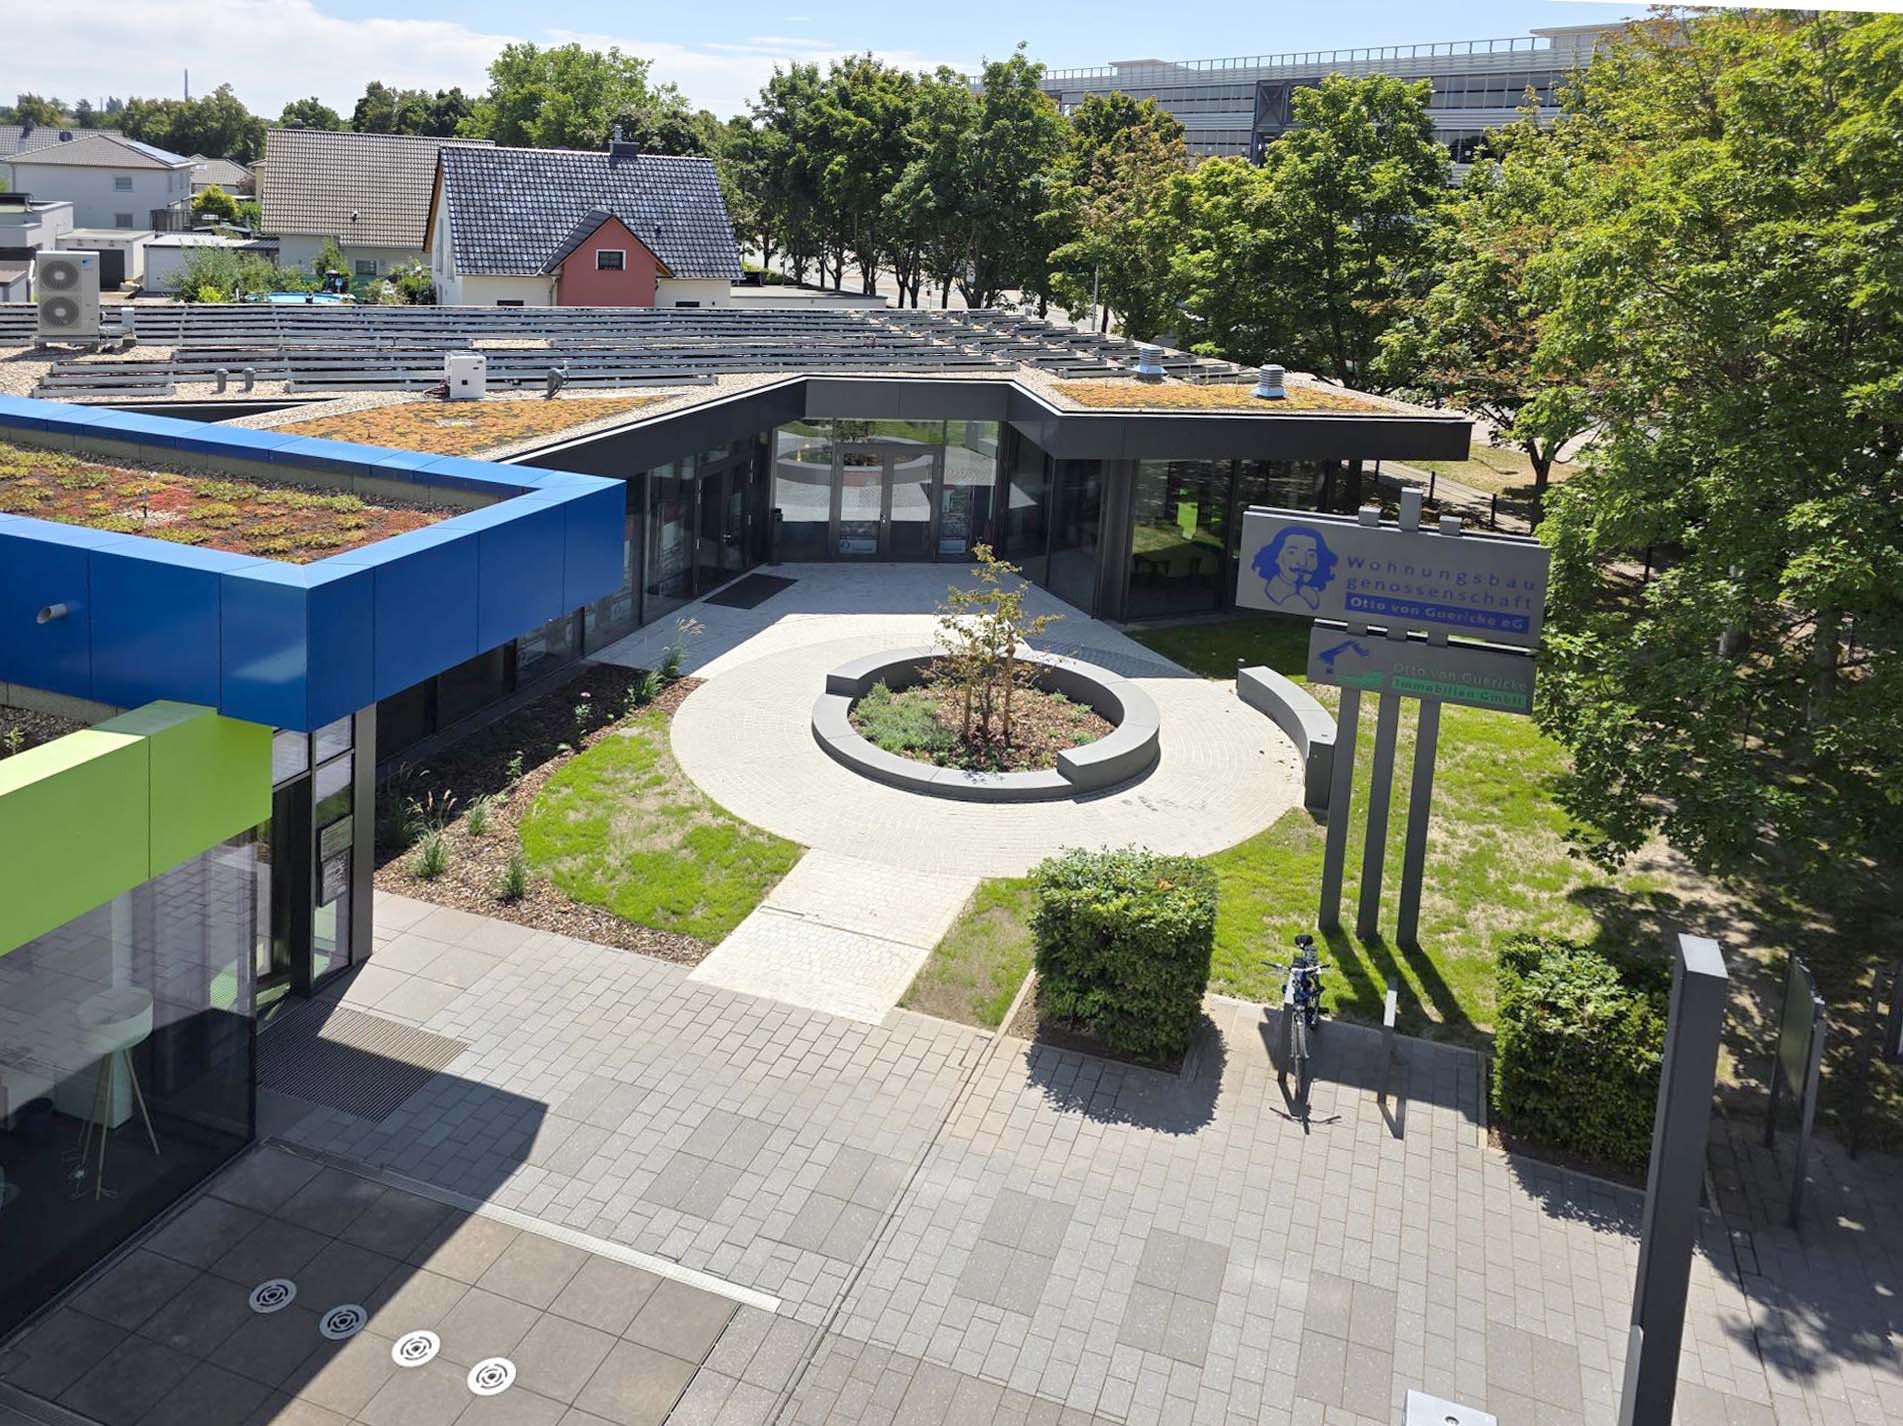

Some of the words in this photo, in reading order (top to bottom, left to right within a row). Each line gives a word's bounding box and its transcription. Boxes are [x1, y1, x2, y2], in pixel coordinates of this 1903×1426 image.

[1347, 555, 1535, 590] Wohnungsbau
[1346, 576, 1532, 609] genossenschaft
[1350, 597, 1386, 610] Otto
[1392, 604, 1419, 616] von
[1424, 607, 1496, 626] Guericke
[1393, 663, 1425, 677] Otto
